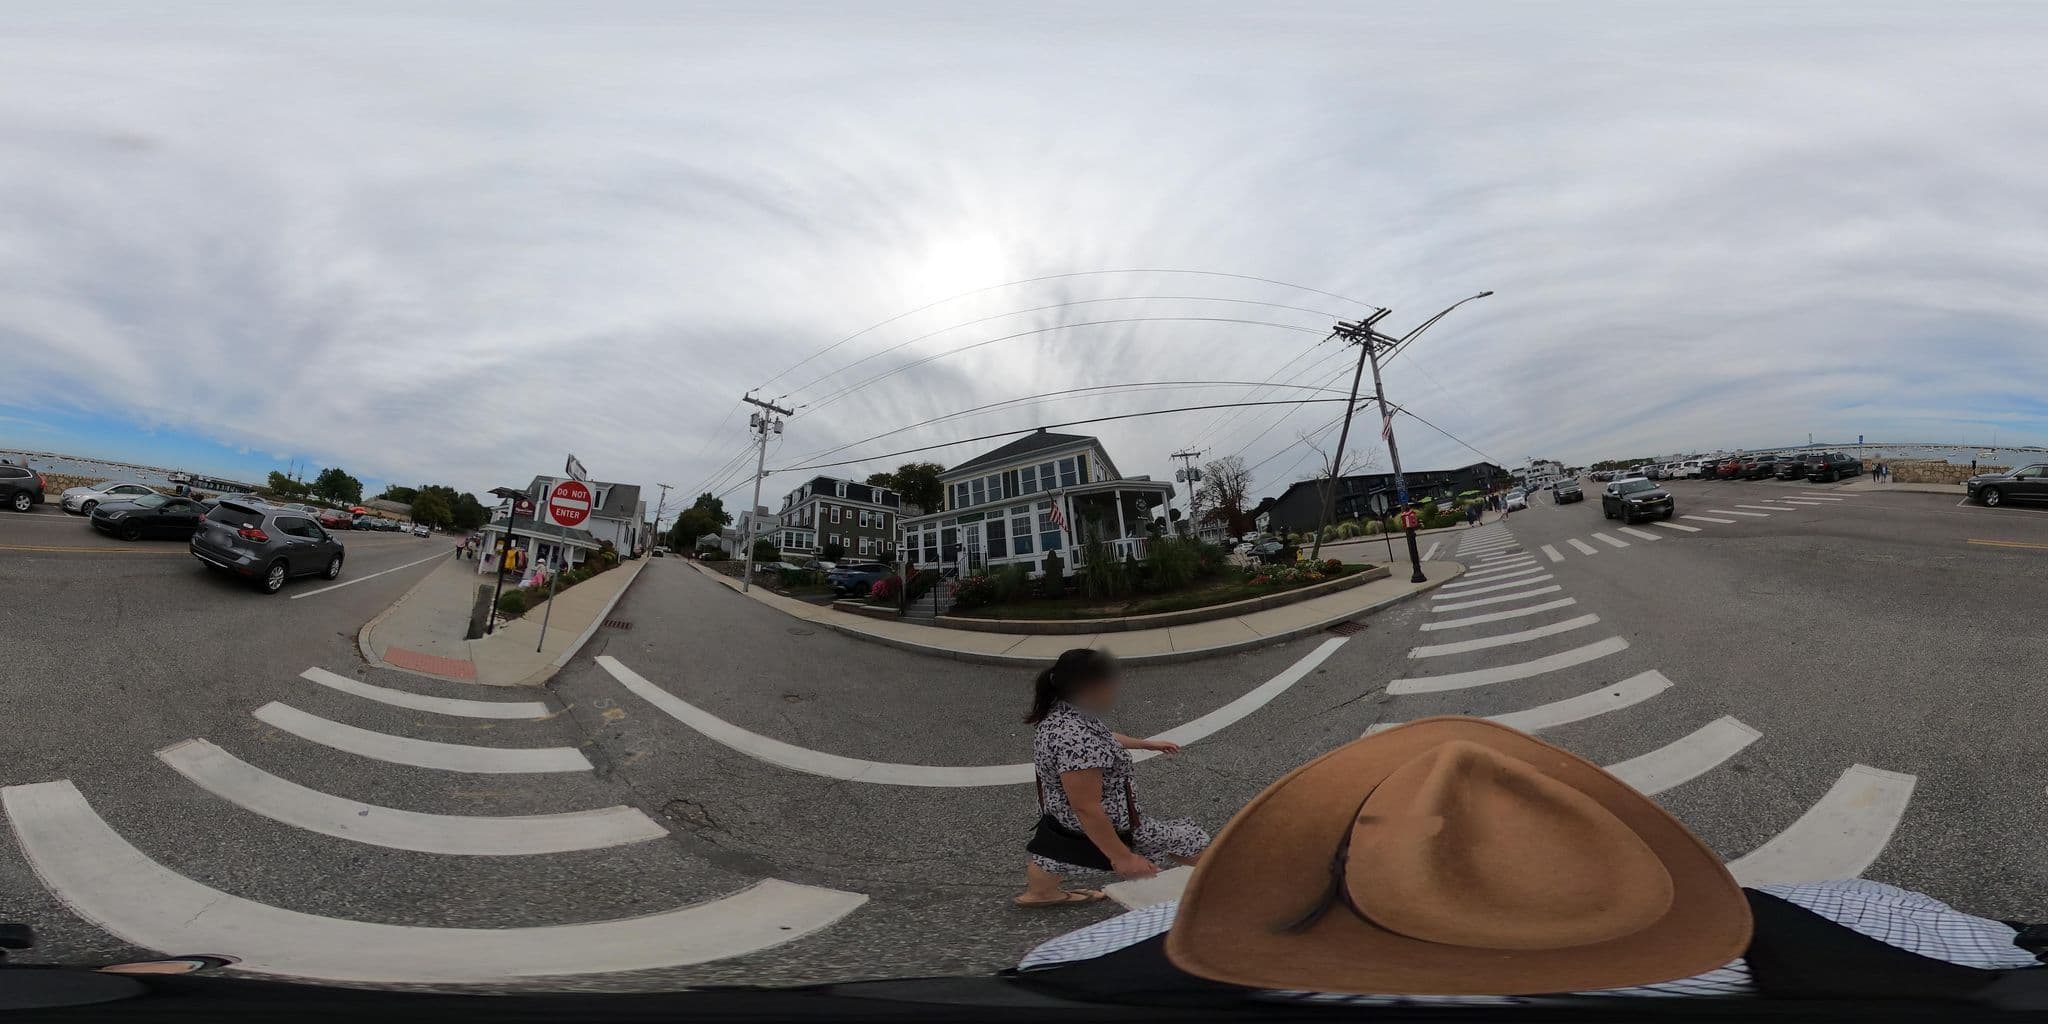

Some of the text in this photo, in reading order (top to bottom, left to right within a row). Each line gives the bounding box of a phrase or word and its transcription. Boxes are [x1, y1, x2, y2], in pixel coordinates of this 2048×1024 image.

[557, 488, 587, 499] DO NOT
[556, 508, 580, 519] ENTER
